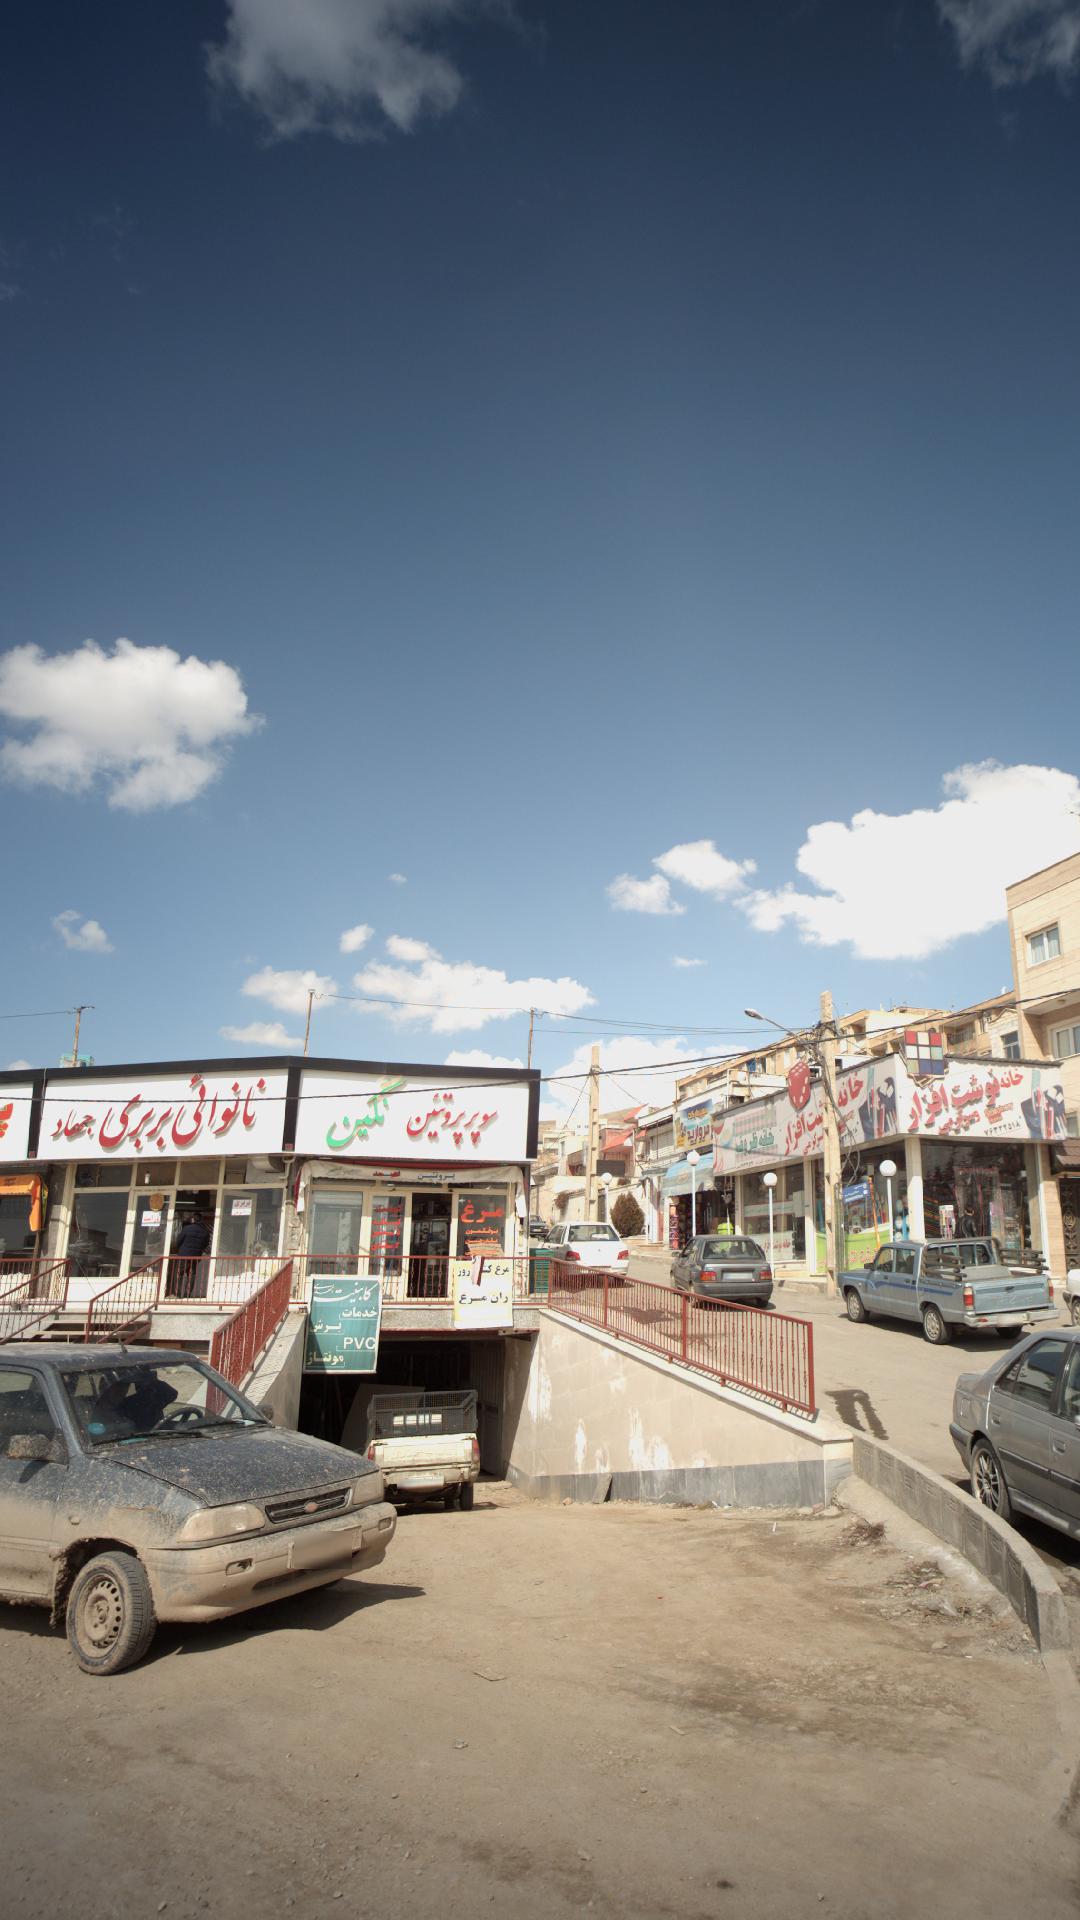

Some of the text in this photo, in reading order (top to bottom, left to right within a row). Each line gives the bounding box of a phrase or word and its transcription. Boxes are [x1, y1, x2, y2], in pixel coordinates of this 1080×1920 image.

[50, 1109, 97, 1137] جهاد
[98, 1093, 173, 1149] بربری
[326, 1078, 498, 1148] سوپر پروتئین نگین
[460, 1200, 504, 1223] مرغ
[342, 1307, 378, 1318] خدمات
[310, 1320, 342, 1333] برش
[343, 1337, 377, 1350] PVC
